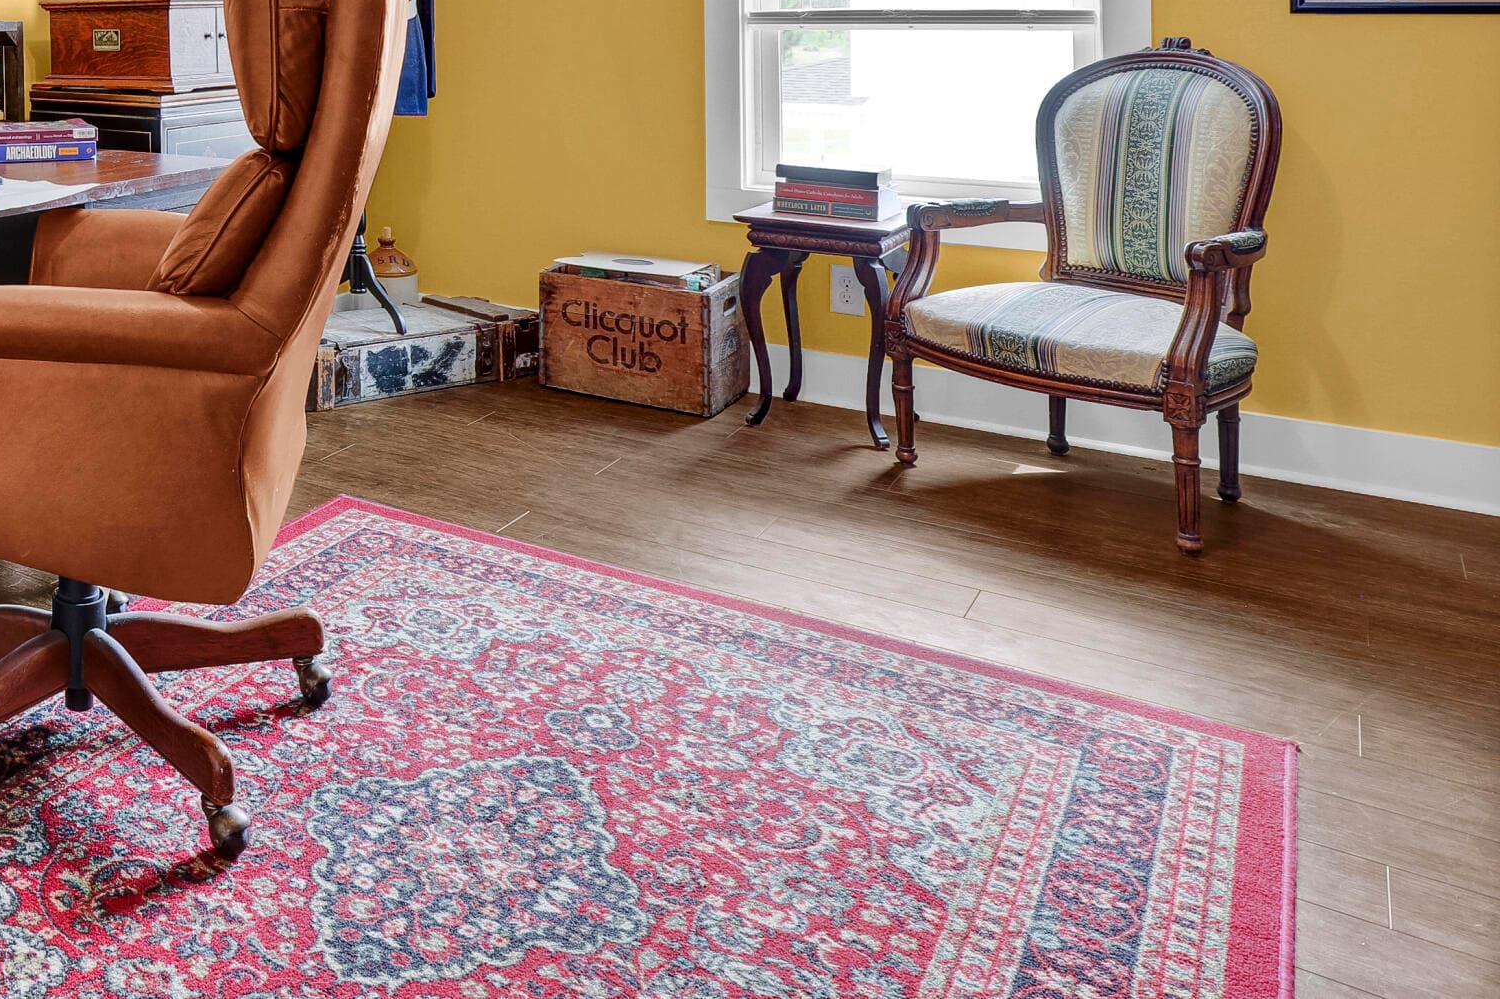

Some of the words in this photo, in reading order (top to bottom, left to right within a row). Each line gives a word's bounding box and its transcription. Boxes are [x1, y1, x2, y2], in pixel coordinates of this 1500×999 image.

[5, 145, 57, 160] ARCHAEOLOGY
[561, 299, 689, 344] Clicquot
[586, 334, 663, 373] Club
